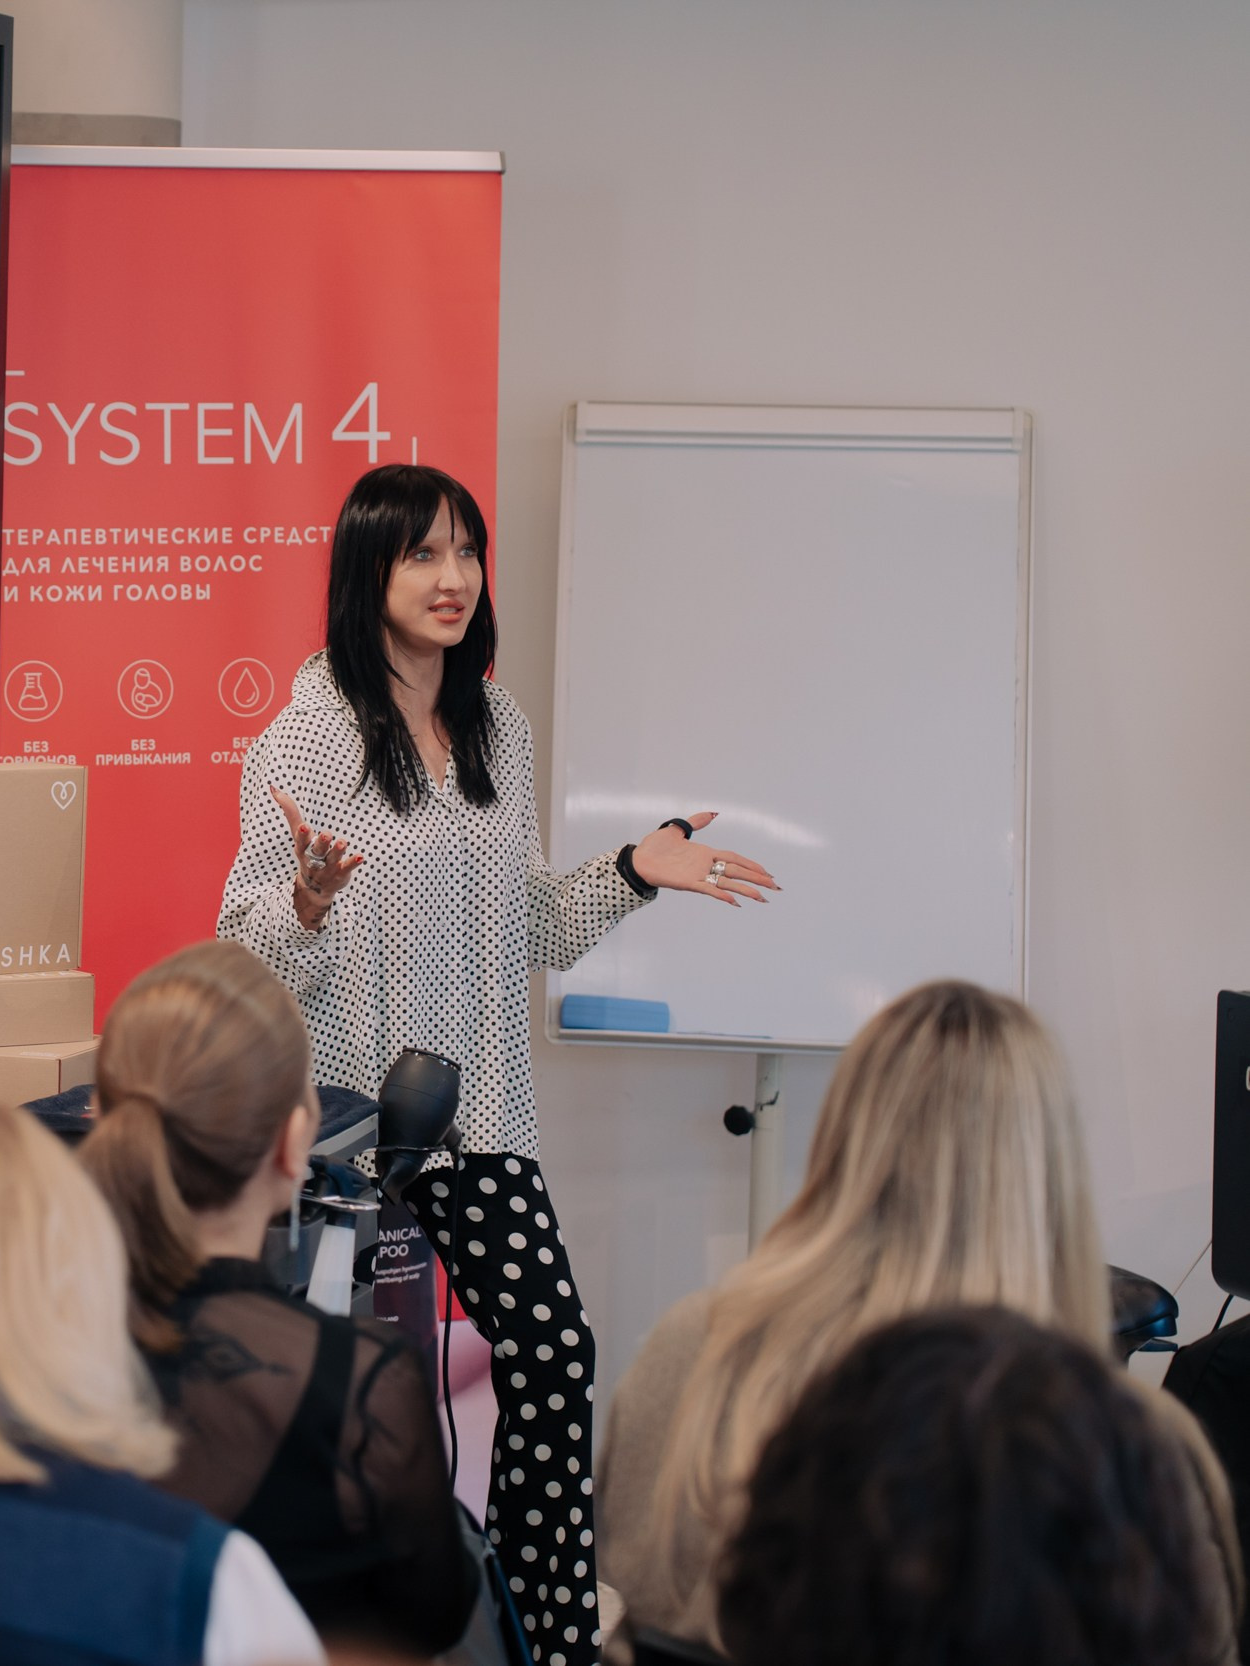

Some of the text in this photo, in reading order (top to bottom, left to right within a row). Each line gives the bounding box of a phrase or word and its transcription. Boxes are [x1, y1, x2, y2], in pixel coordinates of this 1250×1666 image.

[3, 382, 391, 466] SYSTEM 4
[2, 526, 331, 546] ТЕРАПЕВТИЧЕСКИЕ СРЕДСТ
[2, 555, 263, 576] ДЛЯ ЛЕЧЕНИЯ ВОЛОС
[3, 584, 210, 602] И КОЖИ ГОЛОВЫ
[23, 741, 49, 752] БЕЗ
[130, 739, 156, 750] БЕЗ
[95, 752, 191, 766] ПРИВЫКАНИЯ
[378, 1226, 422, 1242] ANICAL
[378, 1244, 409, 1258] POO
